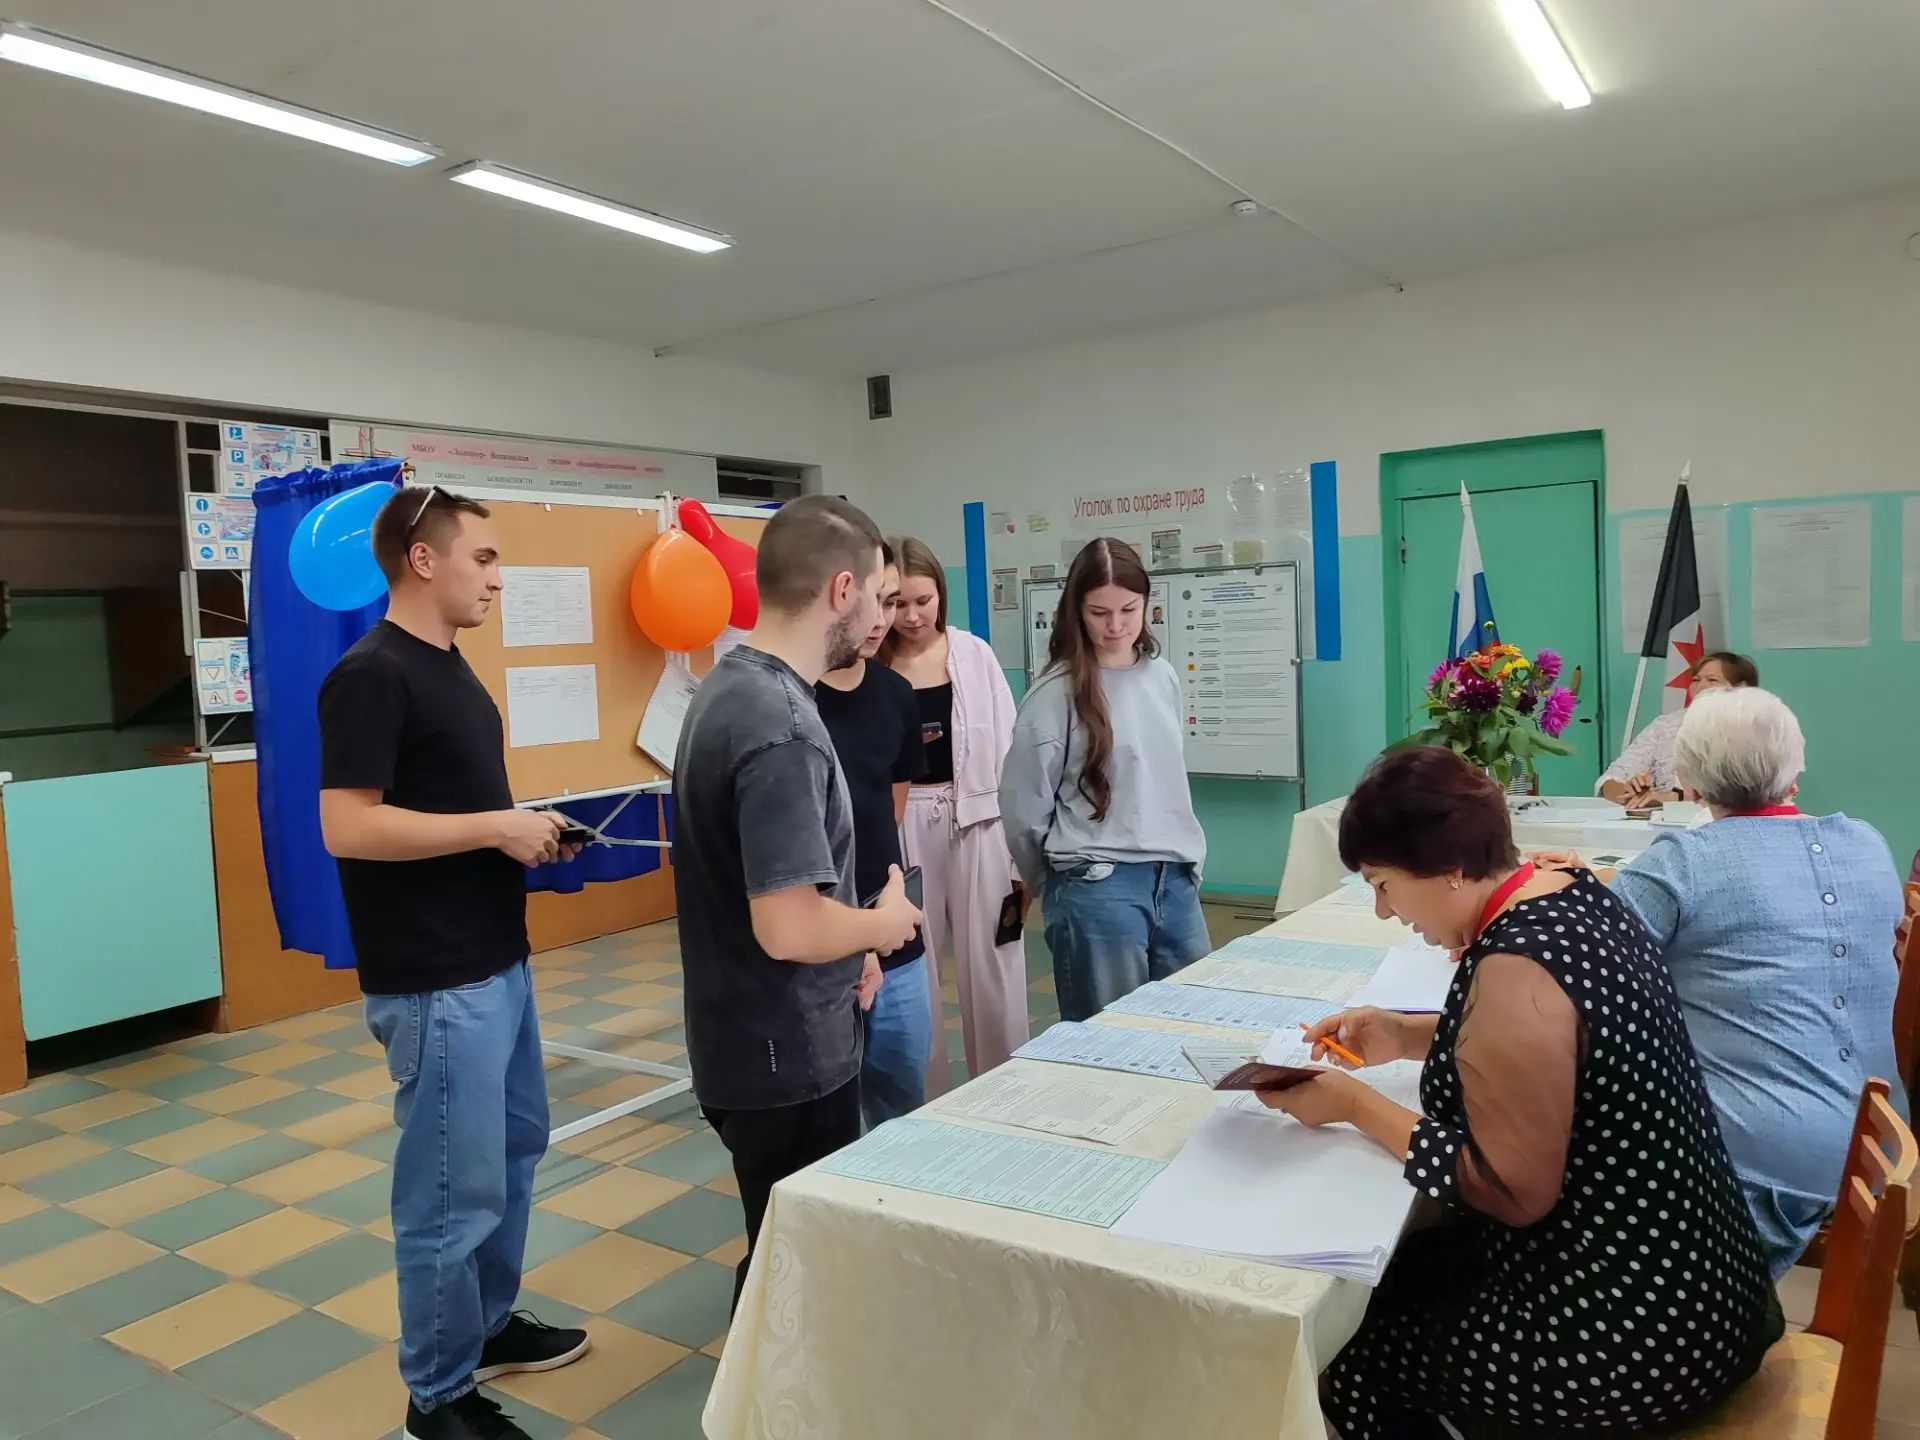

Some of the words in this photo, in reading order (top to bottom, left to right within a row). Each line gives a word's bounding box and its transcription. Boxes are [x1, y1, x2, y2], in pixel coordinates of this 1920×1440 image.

[1073, 497, 1113, 518] Уголок
[1117, 497, 1131, 514] по
[1133, 492, 1172, 517] охране
[1175, 487, 1205, 512] труда
